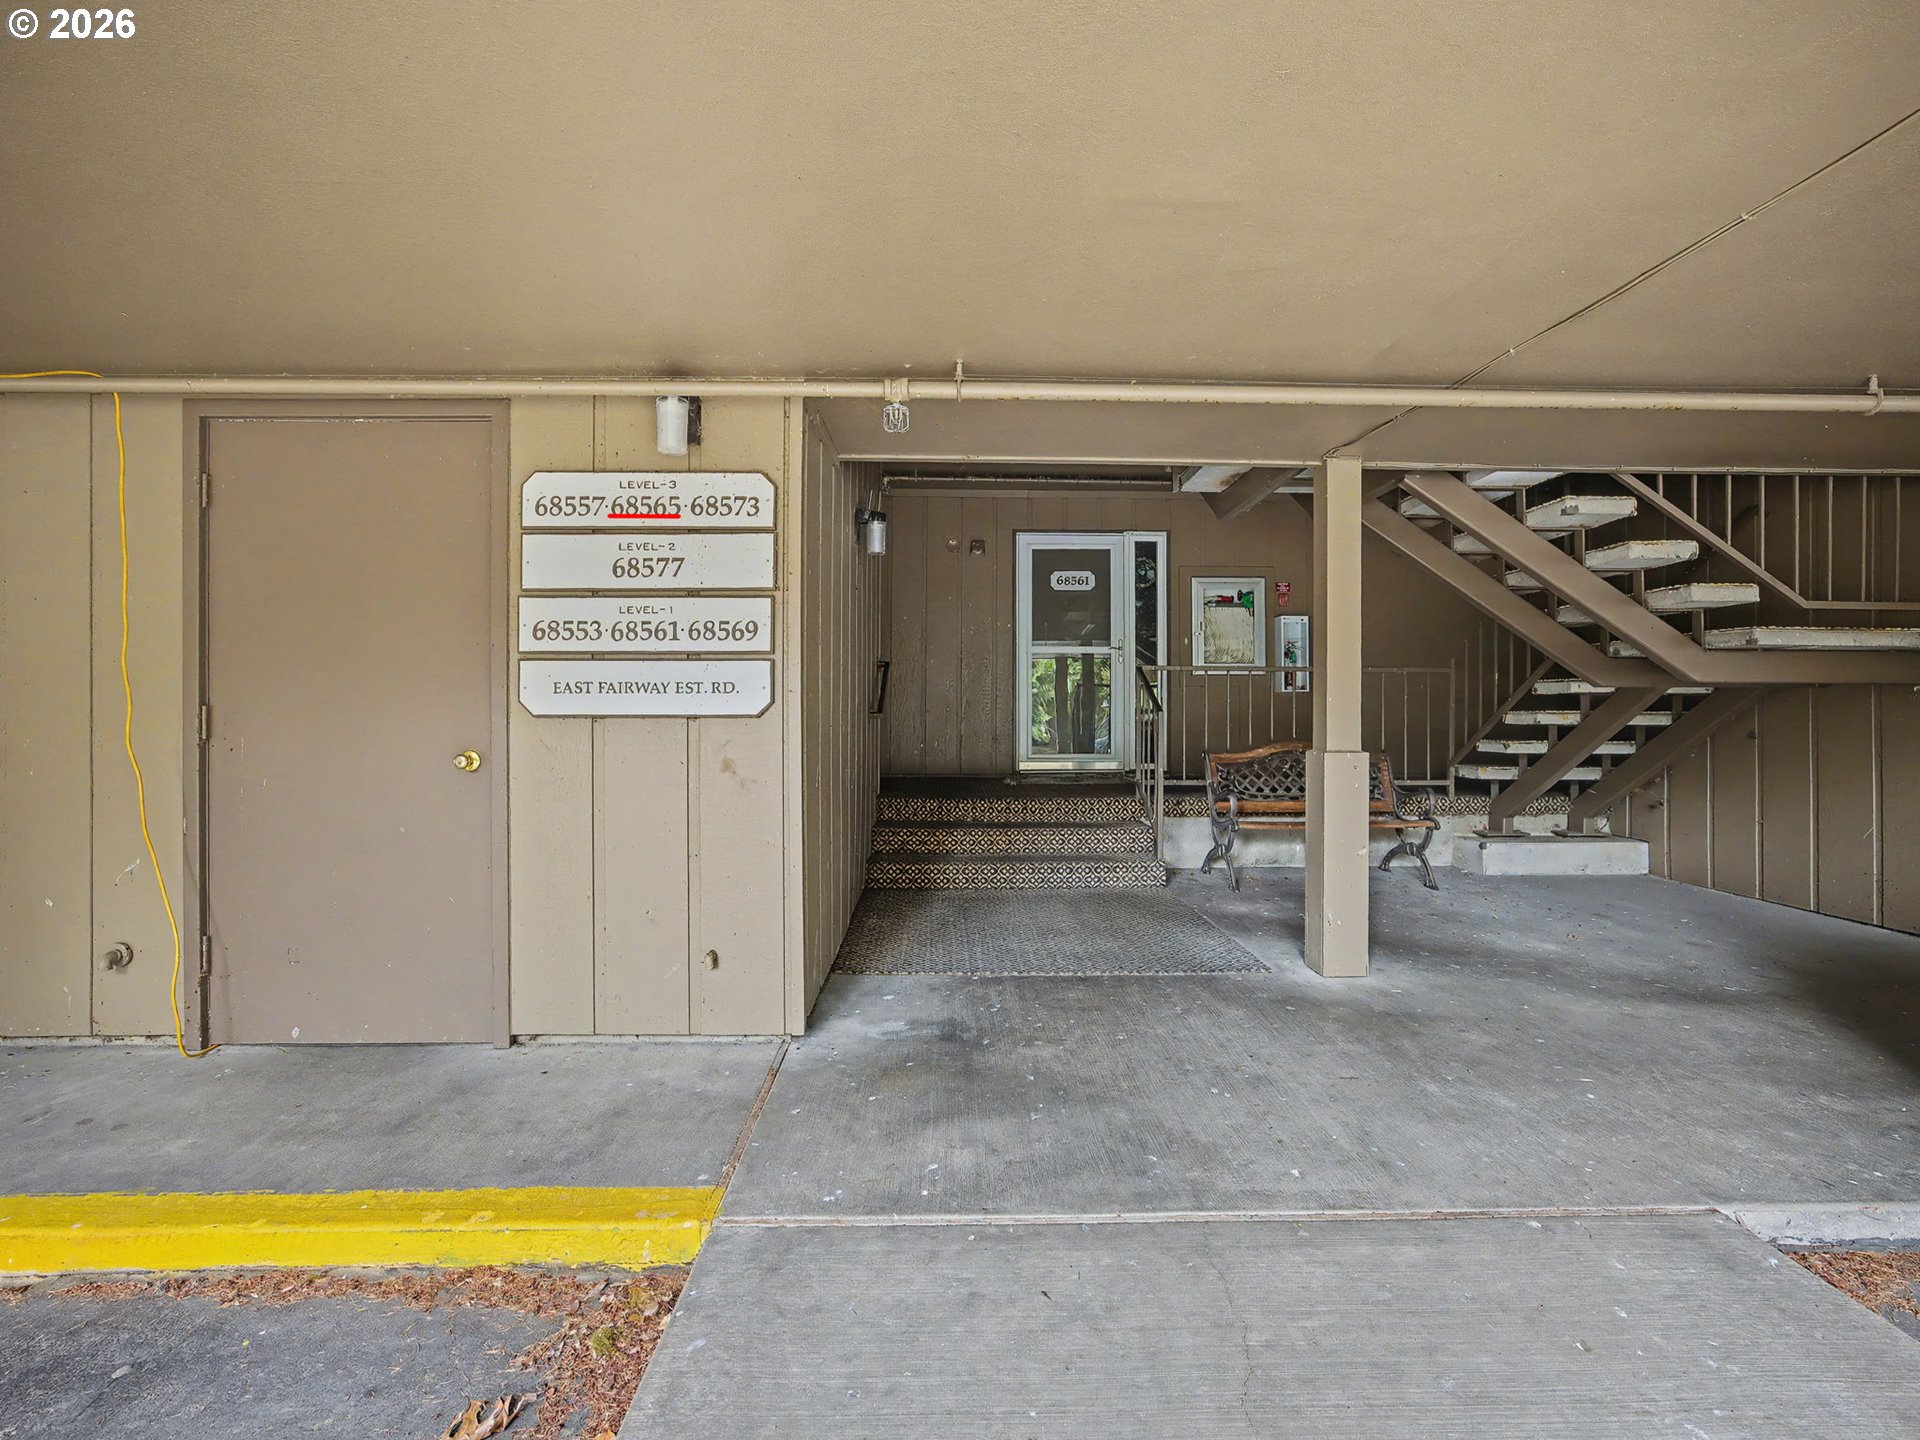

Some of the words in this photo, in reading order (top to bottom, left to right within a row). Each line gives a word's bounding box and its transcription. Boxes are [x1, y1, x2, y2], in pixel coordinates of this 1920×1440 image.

[619, 480, 677, 490] LEVEL-3
[534, 495, 606, 517] 68557
[610, 495, 681, 517] 68565
[690, 495, 760, 517] 68573
[618, 542, 676, 551] LEVEL-2
[612, 557, 685, 578] 68577
[1056, 575, 1090, 586] 68561
[619, 605, 674, 615] LEVEL-1
[532, 620, 603, 641] 68553
[610, 620, 681, 642] 68561
[688, 620, 759, 642] 68569
[553, 681, 594, 694] EAST
[598, 681, 671, 694] FAIRWAY
[675, 681, 708, 694] EST.
[711, 681, 740, 695] RD.
